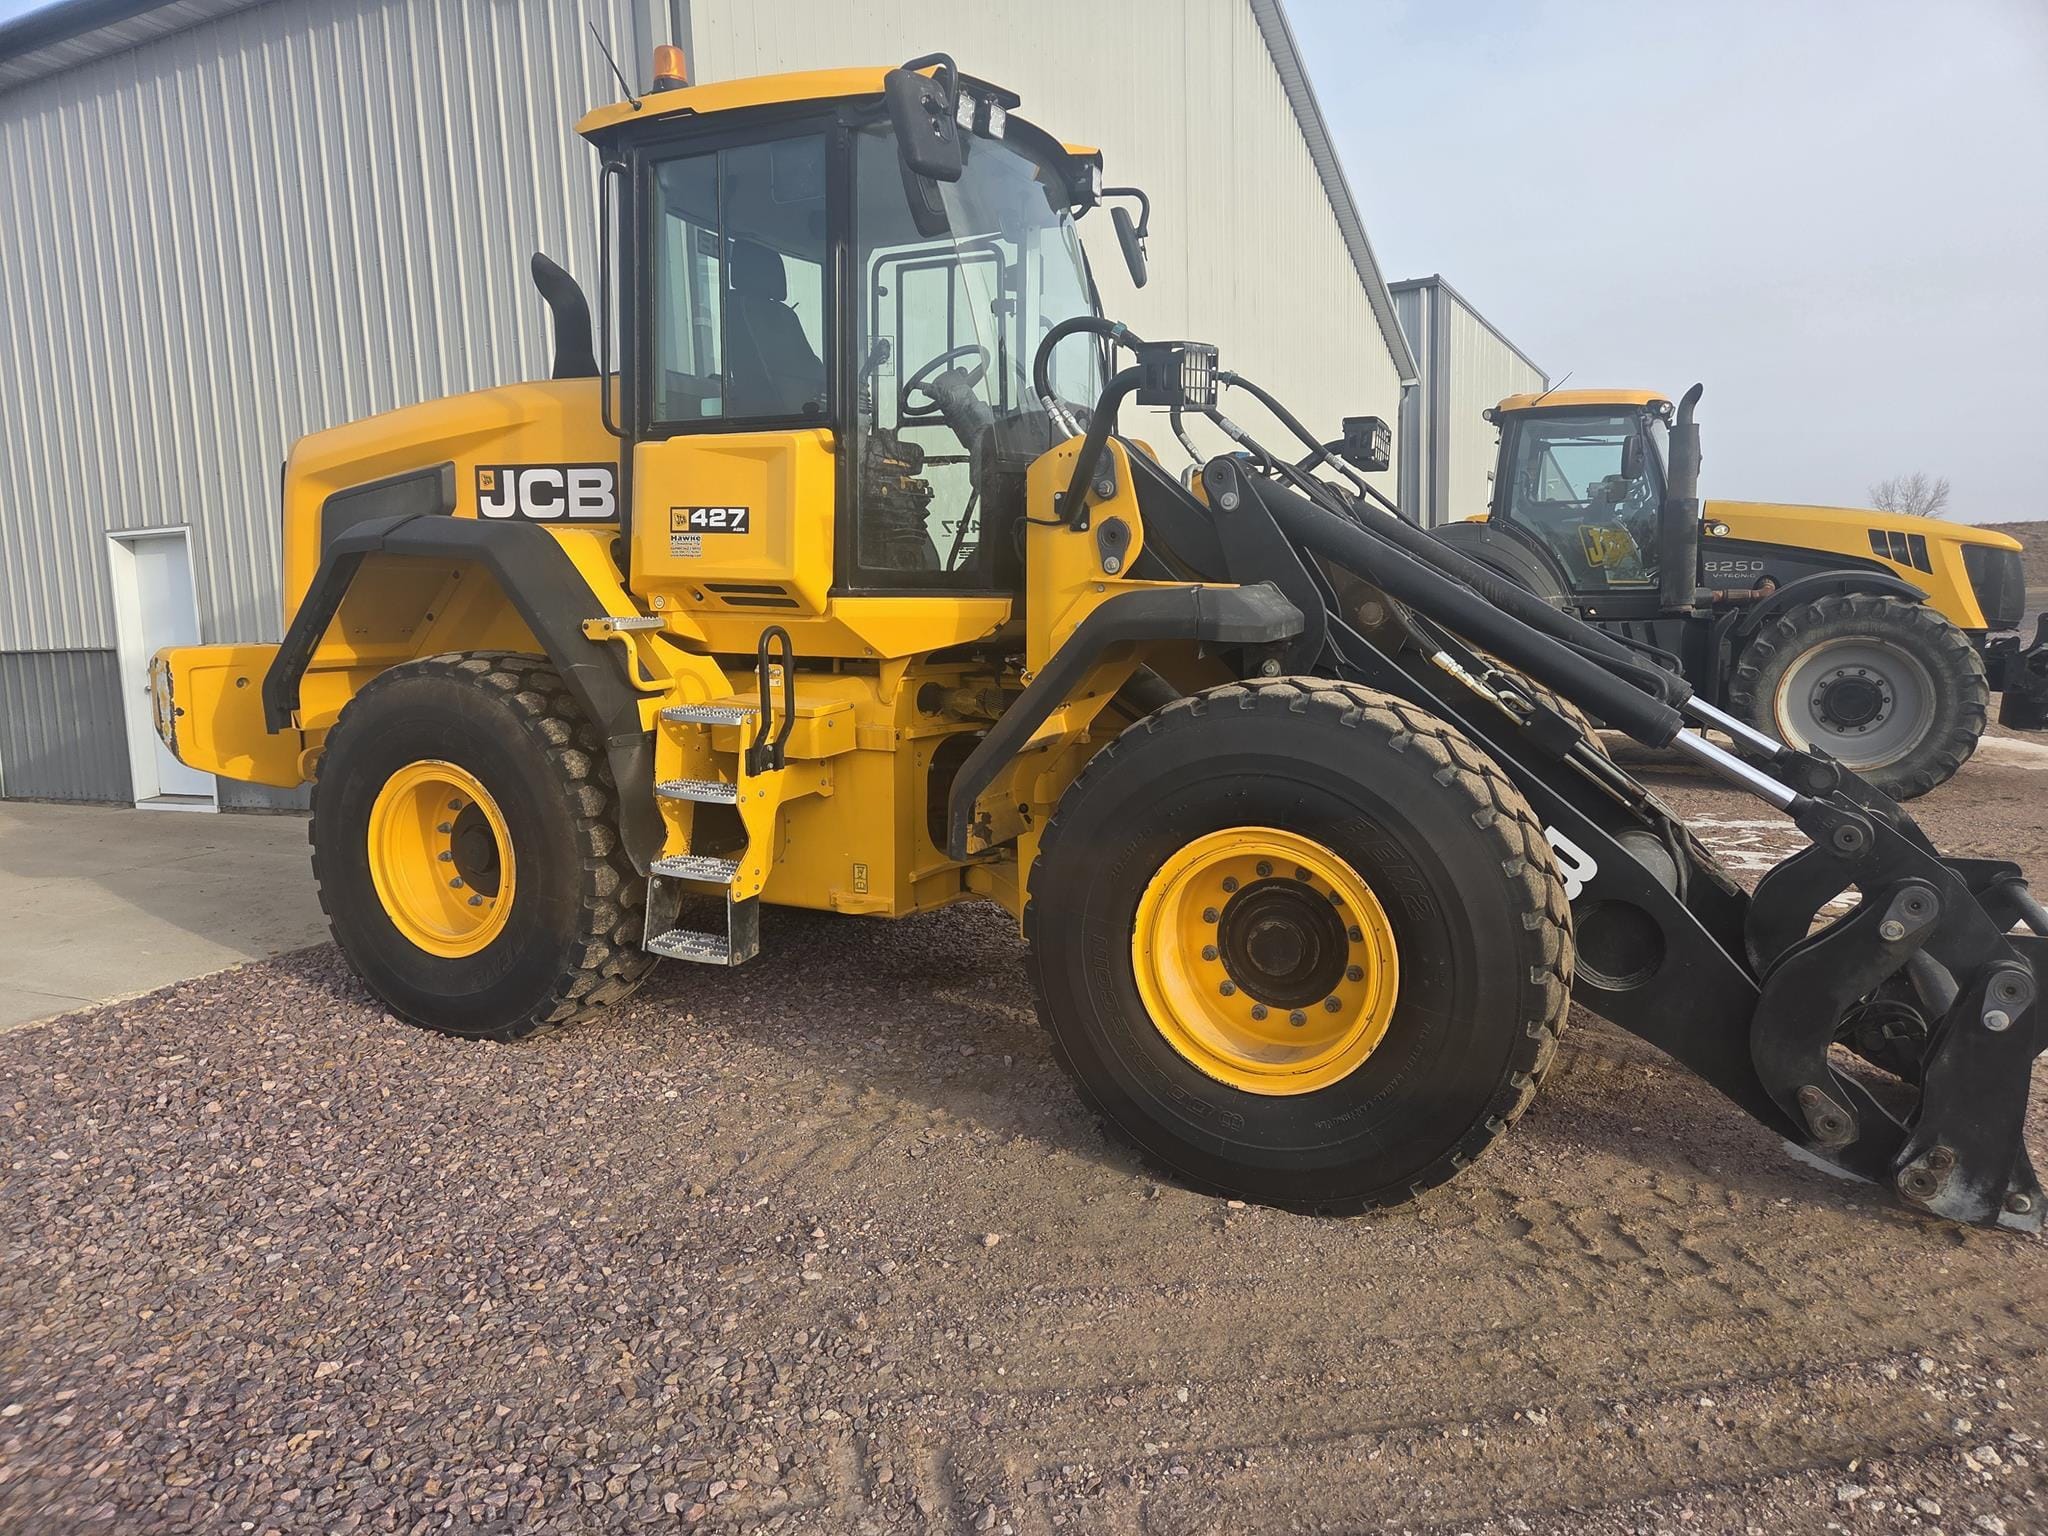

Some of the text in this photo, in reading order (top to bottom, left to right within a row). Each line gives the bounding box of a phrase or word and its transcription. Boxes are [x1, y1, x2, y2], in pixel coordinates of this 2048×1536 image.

[480, 468, 616, 518] JCB
[690, 508, 746, 527] 427
[1704, 561, 1764, 572] 8250
